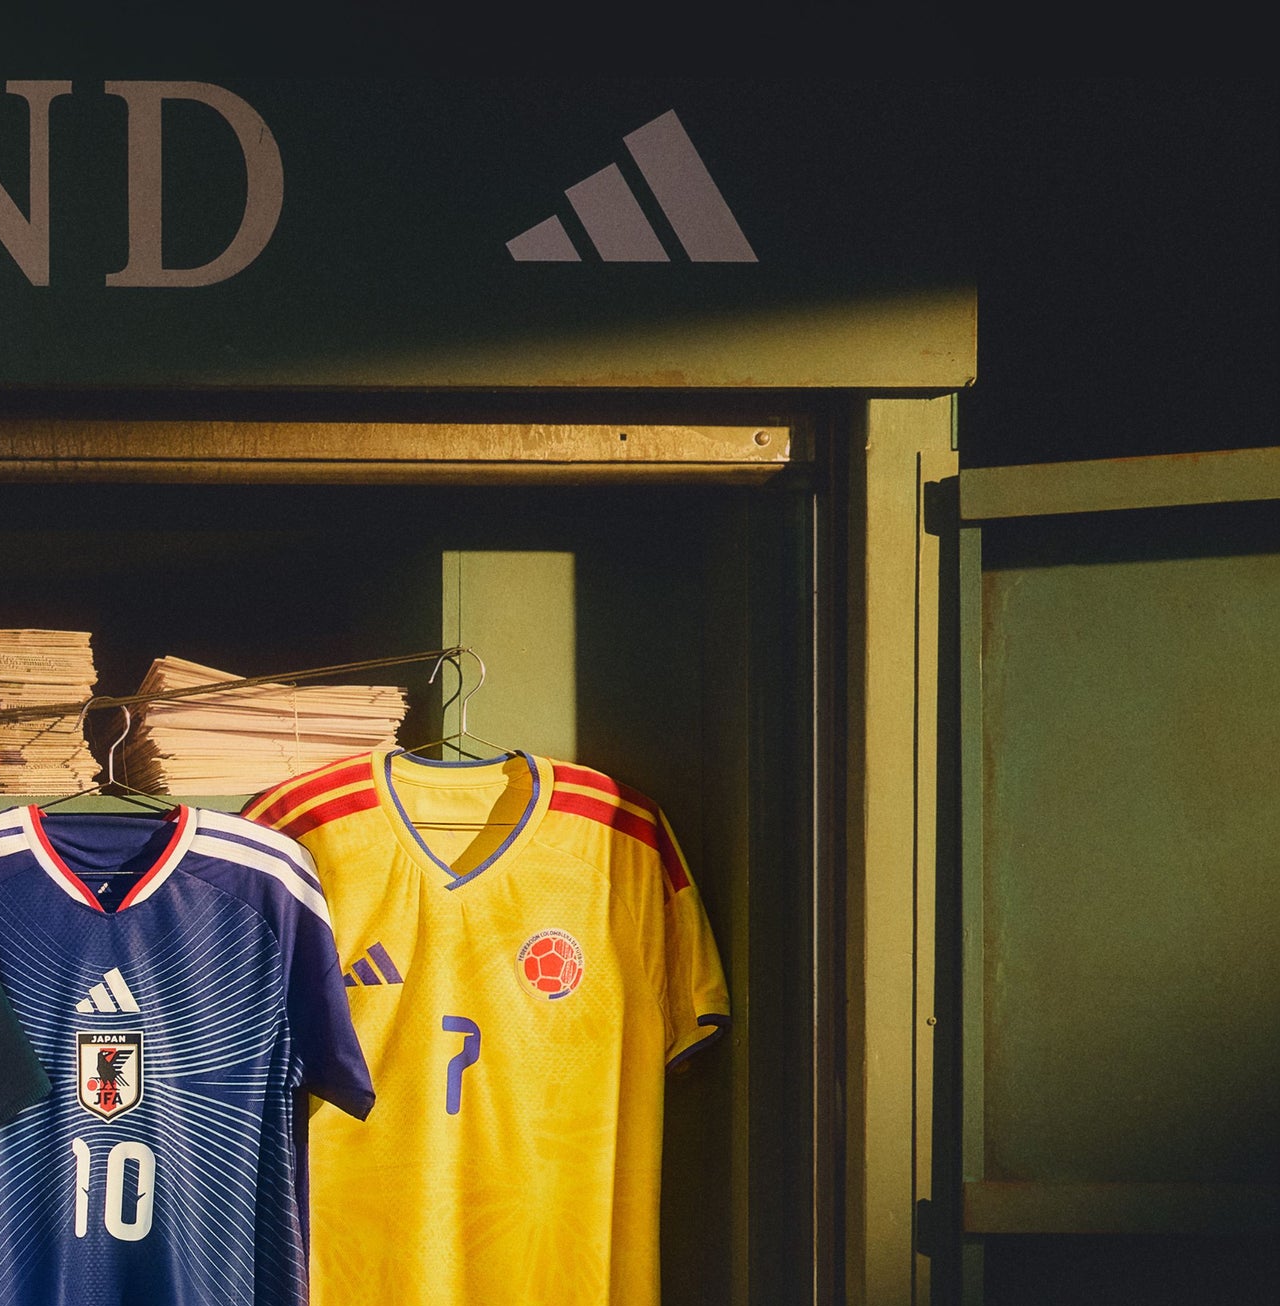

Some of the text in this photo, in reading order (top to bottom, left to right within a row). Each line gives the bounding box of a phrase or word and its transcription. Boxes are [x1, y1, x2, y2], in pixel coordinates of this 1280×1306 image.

[91, 1034, 127, 1043] JAPAN
[442, 1015, 481, 1115] 7
[94, 1092, 123, 1106] JFA
[72, 1137, 156, 1241] 10
